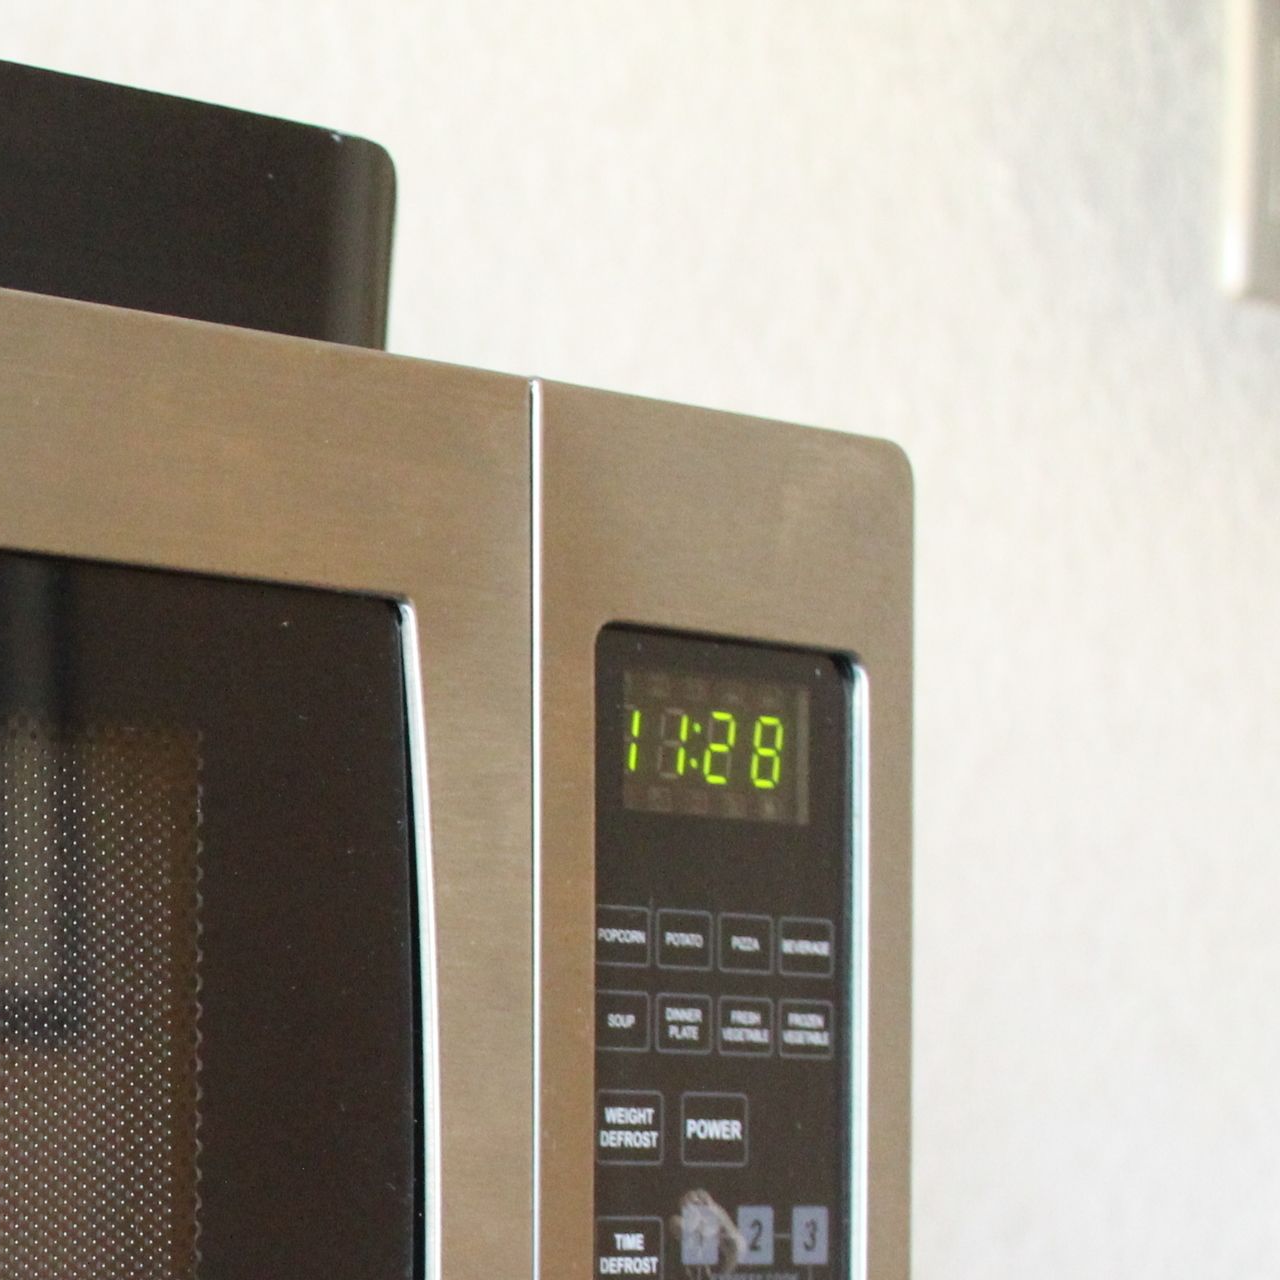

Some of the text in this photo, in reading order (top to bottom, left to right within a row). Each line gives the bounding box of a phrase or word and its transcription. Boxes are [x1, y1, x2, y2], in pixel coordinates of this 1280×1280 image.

[627, 709, 783, 789] 11:28
[597, 927, 646, 944] POPCORN
[665, 931, 704, 948] POTATO
[730, 935, 760, 951] PIZZA
[607, 1013, 635, 1028] SOUP
[668, 1025, 699, 1041] PLATE
[604, 1107, 655, 1124] WEIGHT
[686, 1118, 742, 1140] POWER
[600, 1130, 658, 1148] DEFROST
[614, 1233, 645, 1251] TIME
[749, 1219, 763, 1251] 2
[803, 1218, 818, 1251] 3
[600, 1256, 658, 1275] DEFROST
